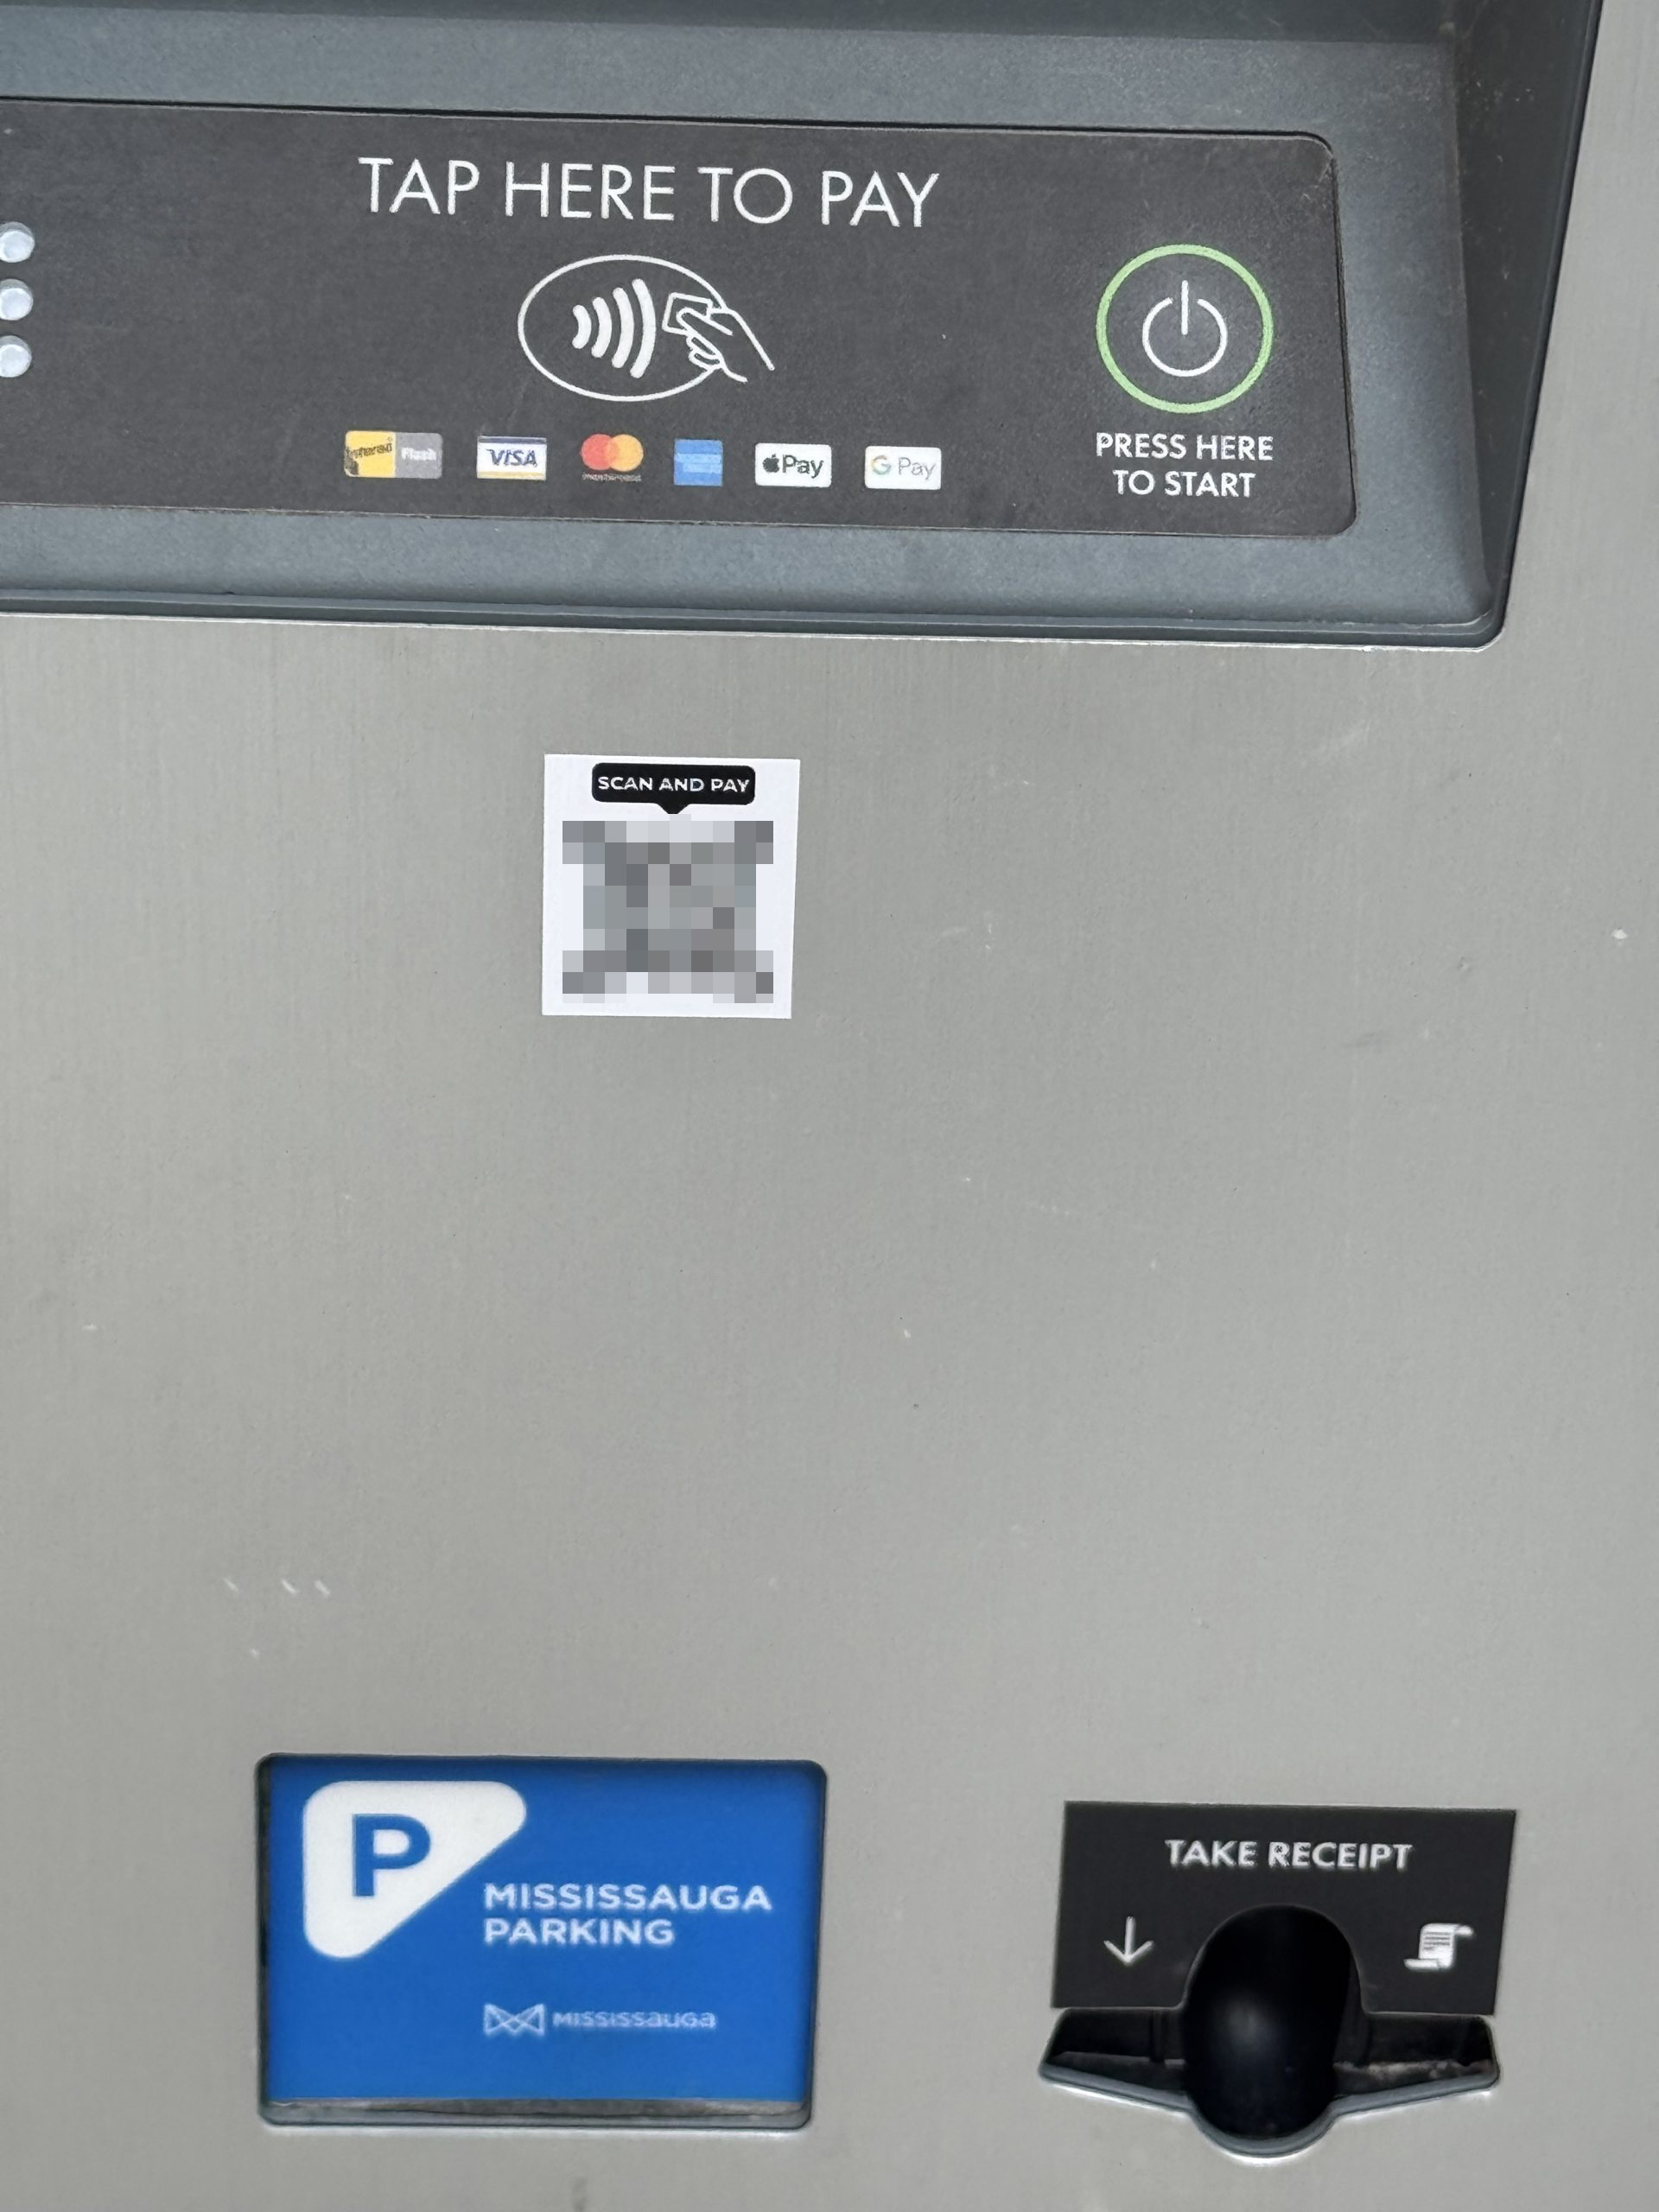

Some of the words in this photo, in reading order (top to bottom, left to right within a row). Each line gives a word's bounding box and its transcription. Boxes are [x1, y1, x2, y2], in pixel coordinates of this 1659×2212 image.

[359, 156, 480, 215] TAP
[505, 162, 677, 222] HERE
[698, 166, 794, 225] TO
[821, 170, 940, 227] PAY
[486, 448, 538, 467] VISA
[1096, 432, 1187, 460] PRESS
[1196, 435, 1274, 461] HERE
[782, 454, 825, 479] Pay
[898, 456, 938, 481] Pay
[1113, 469, 1156, 495] TO
[1164, 471, 1256, 498] START
[598, 776, 653, 791] SCAN
[658, 778, 705, 791] AND
[710, 779, 750, 793] PAY
[352, 1813, 431, 1897] P
[1164, 1839, 1258, 1867] TAKE
[1267, 1840, 1414, 1872] RECEIPT
[483, 1882, 773, 1912] MISSISSAUGA
[484, 1916, 677, 1947] PARKING
